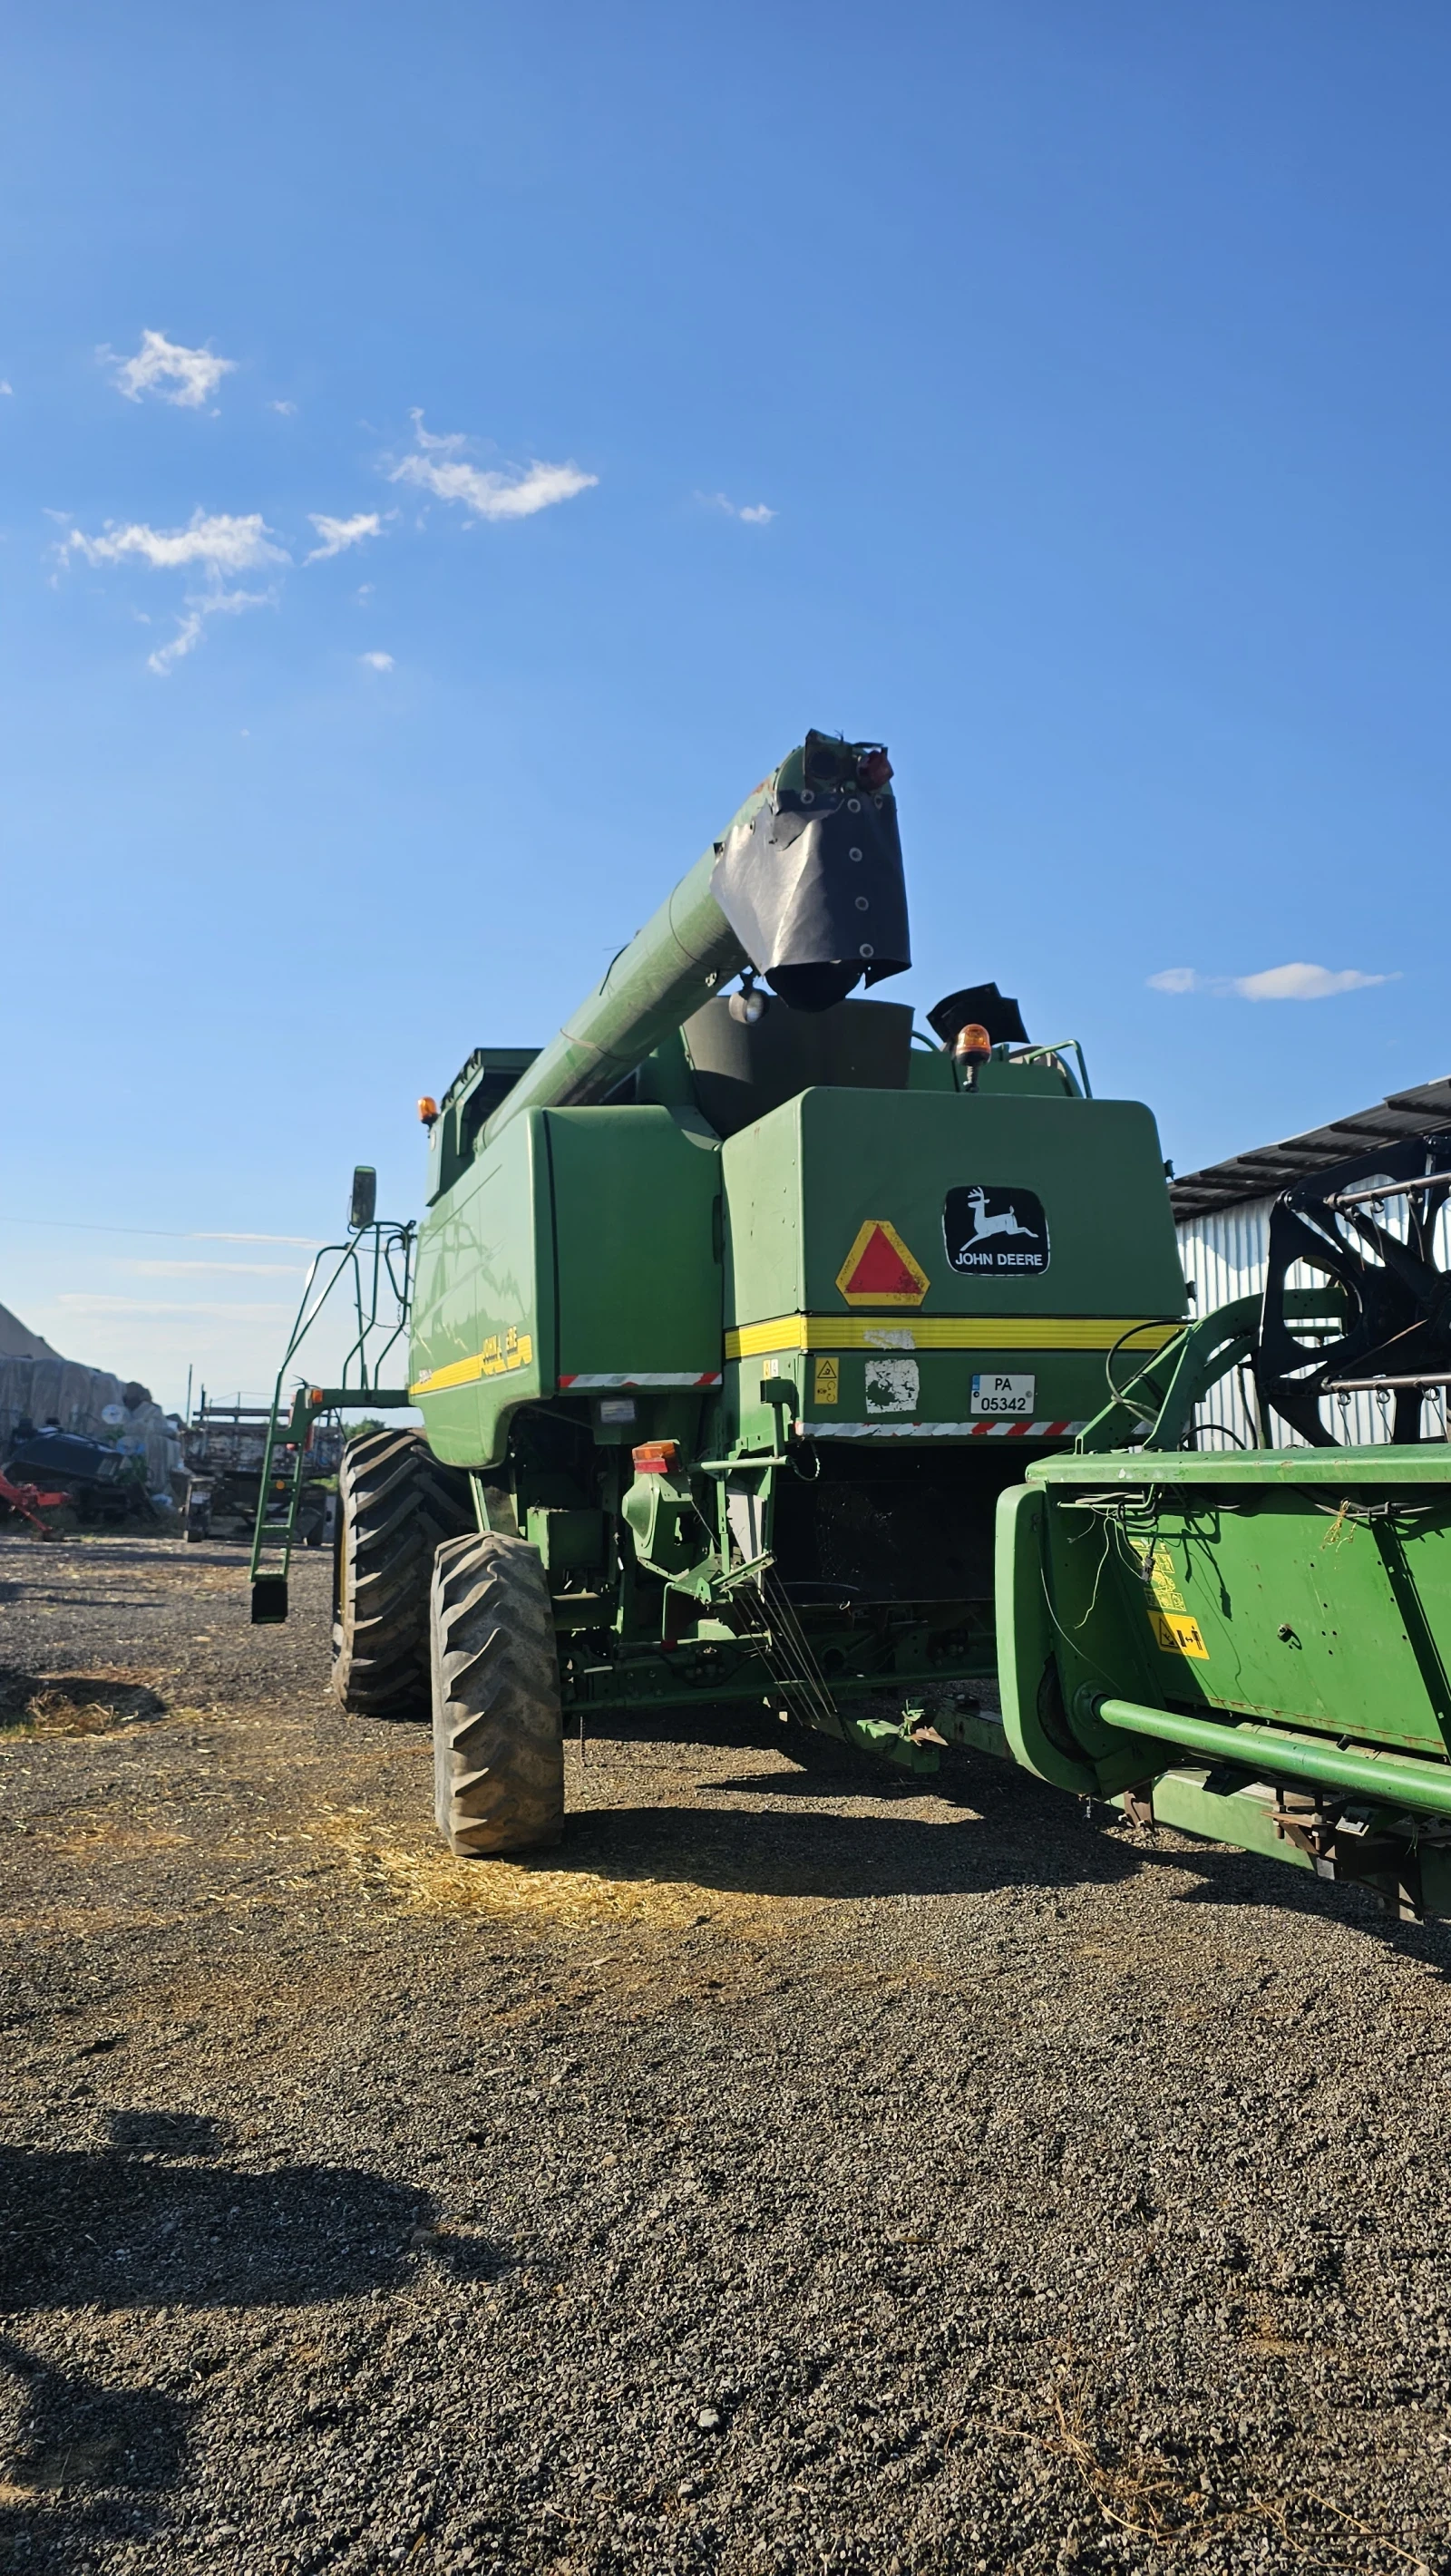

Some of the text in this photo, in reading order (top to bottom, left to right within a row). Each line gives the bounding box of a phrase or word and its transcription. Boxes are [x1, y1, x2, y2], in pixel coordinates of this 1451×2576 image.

[955, 1253, 1043, 1266] JOHN DEERE
[995, 1377, 1012, 1391] PA
[981, 1397, 1026, 1411] 05342
